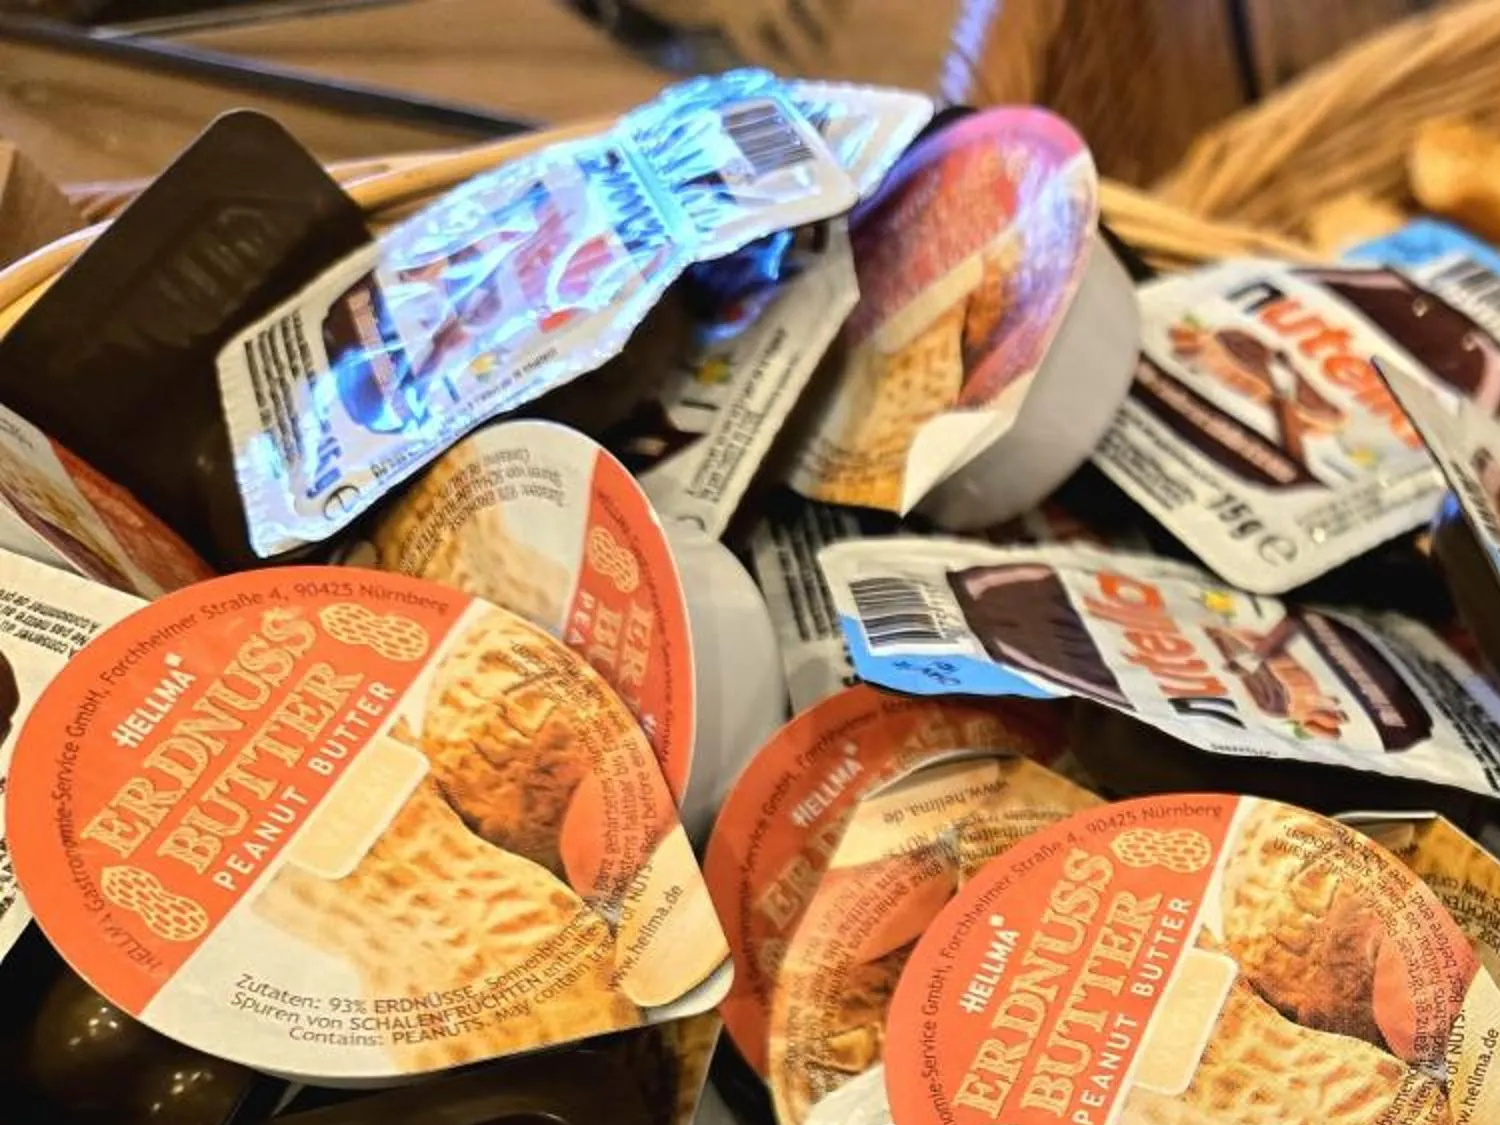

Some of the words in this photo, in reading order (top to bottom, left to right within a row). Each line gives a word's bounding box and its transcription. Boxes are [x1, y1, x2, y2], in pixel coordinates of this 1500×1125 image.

[293, 582, 354, 599] 90425
[357, 581, 450, 615] Nürnberg
[80, 606, 317, 860] ERDNUSS
[111, 669, 197, 750] HELLMA
[156, 661, 365, 875] BUTTER
[212, 785, 309, 892] PEANUT
[308, 681, 397, 776] BUTTER
[607, 883, 683, 992] www.hellma.de
[922, 966, 953, 1016] GmbH,
[1086, 812, 1137, 834] 90425
[1142, 803, 1222, 823] Nürnberg
[1131, 897, 1193, 997] BUTTER
[230, 991, 299, 1027] Spuren
[307, 1014, 343, 1029] von
[350, 976, 542, 1031] SCHALENFRÜCHTEN
[236, 974, 320, 1010] Zutaten:
[329, 996, 367, 1014] 93%
[952, 848, 1114, 1120] ERDNUSS
[959, 930, 1021, 1014] HELLMA
[1020, 891, 1163, 1118] BUTTER
[289, 1026, 383, 1047] Contains:
[393, 1019, 484, 1045] PEANUTS.
